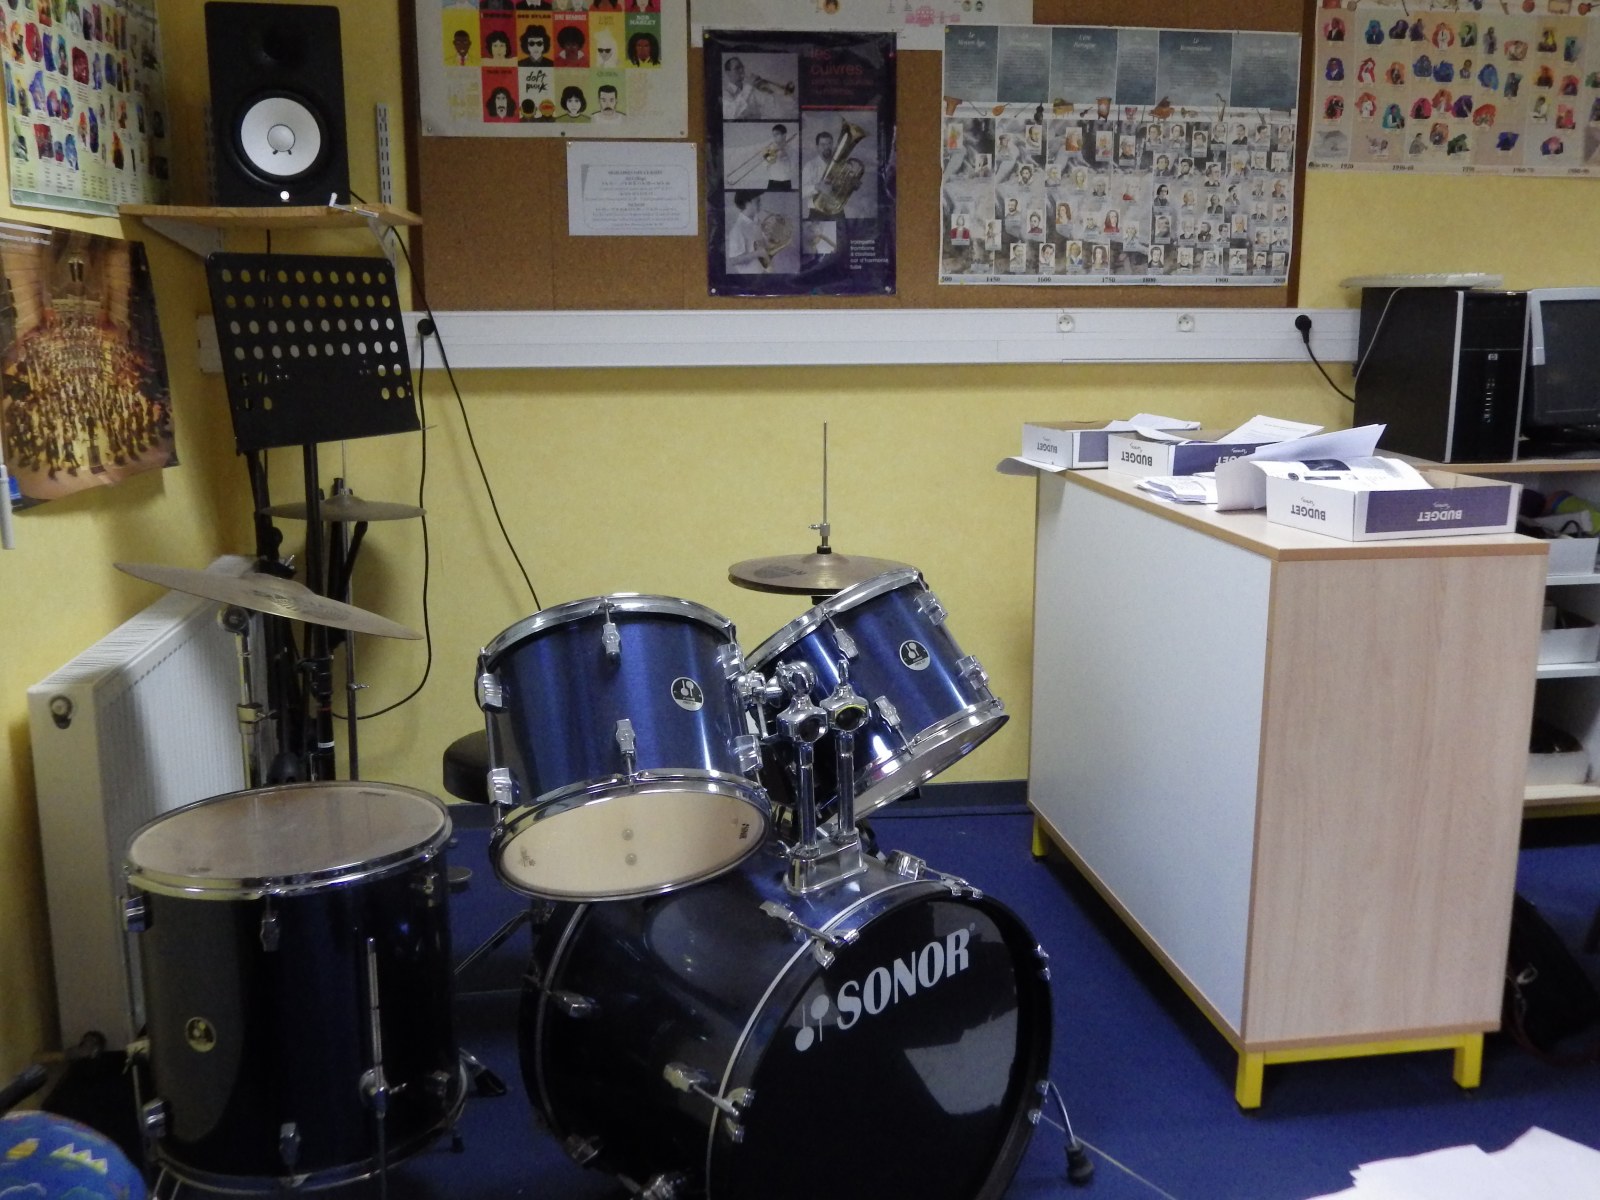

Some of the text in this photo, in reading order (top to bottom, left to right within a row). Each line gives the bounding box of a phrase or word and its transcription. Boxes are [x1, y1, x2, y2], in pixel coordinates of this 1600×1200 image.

[810, 64, 863, 76] cuivres
[1036, 442, 1058, 454] BUDGET
[1121, 451, 1153, 467] BUDGET
[1291, 504, 1326, 521] BUDGET
[1417, 510, 1463, 522] BUDGET
[837, 928, 970, 1030] SONOR
